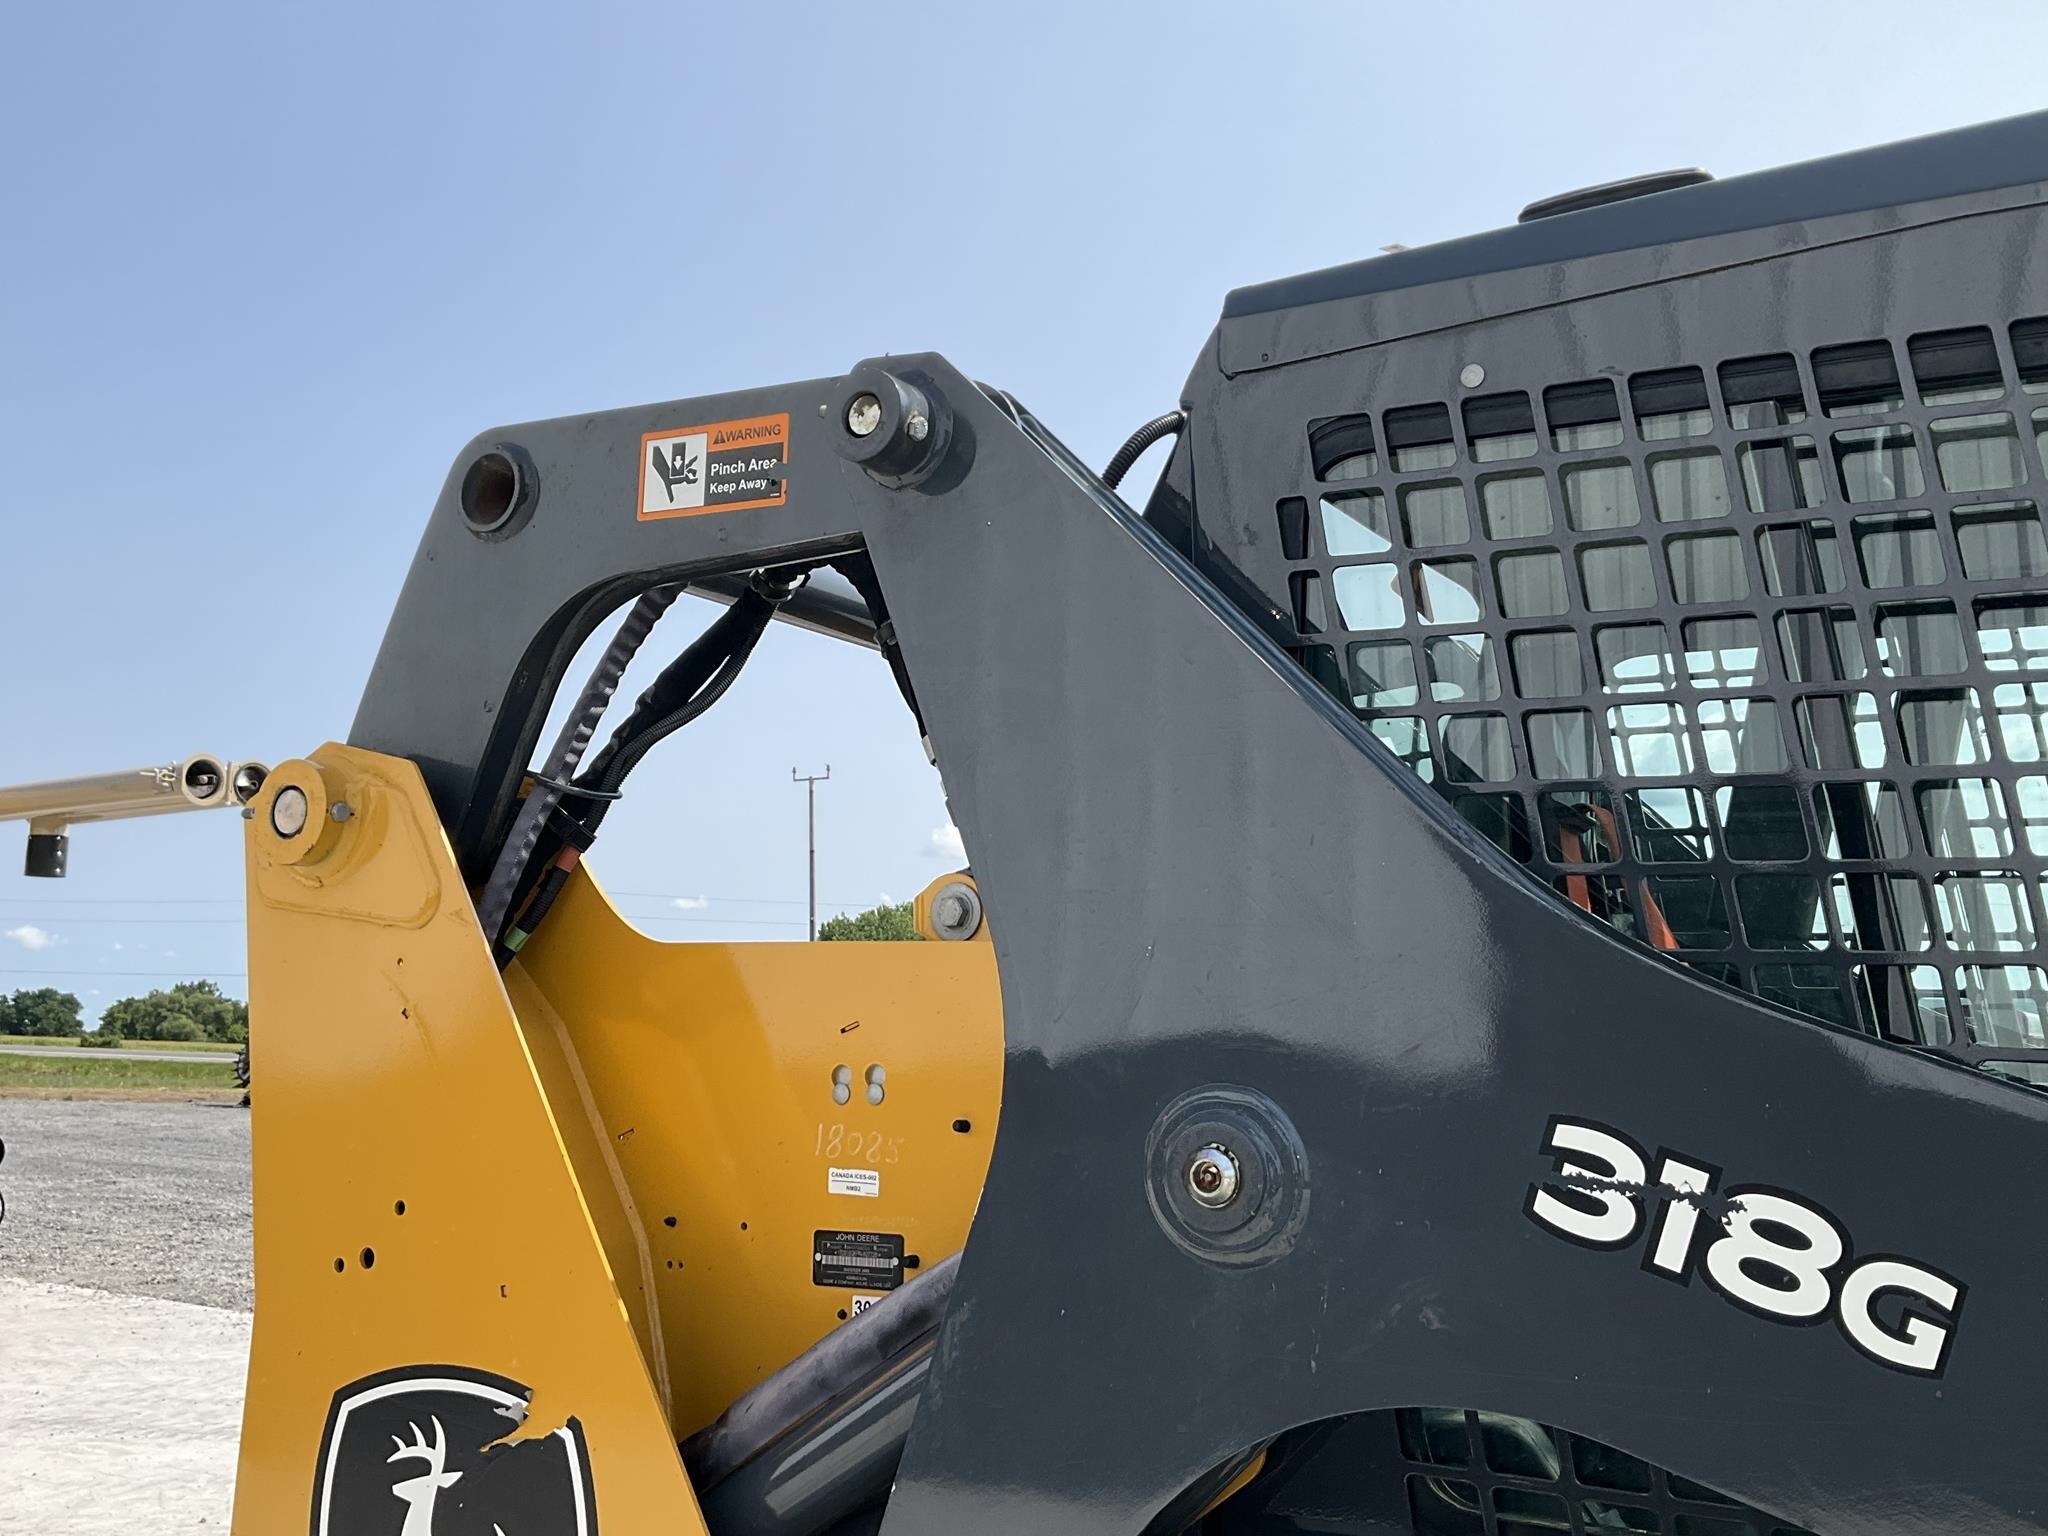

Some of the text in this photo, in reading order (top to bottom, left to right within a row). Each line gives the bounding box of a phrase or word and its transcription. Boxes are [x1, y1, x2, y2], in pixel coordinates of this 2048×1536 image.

[726, 424, 781, 442] WARNING
[711, 460, 745, 476] Pinch
[709, 479, 767, 494] Keep Away
[815, 1122, 904, 1165] 18085
[831, 1171, 853, 1179] CANADA
[835, 1233, 880, 1242] JOHN DEERE
[1528, 1119, 1963, 1375] 318G
